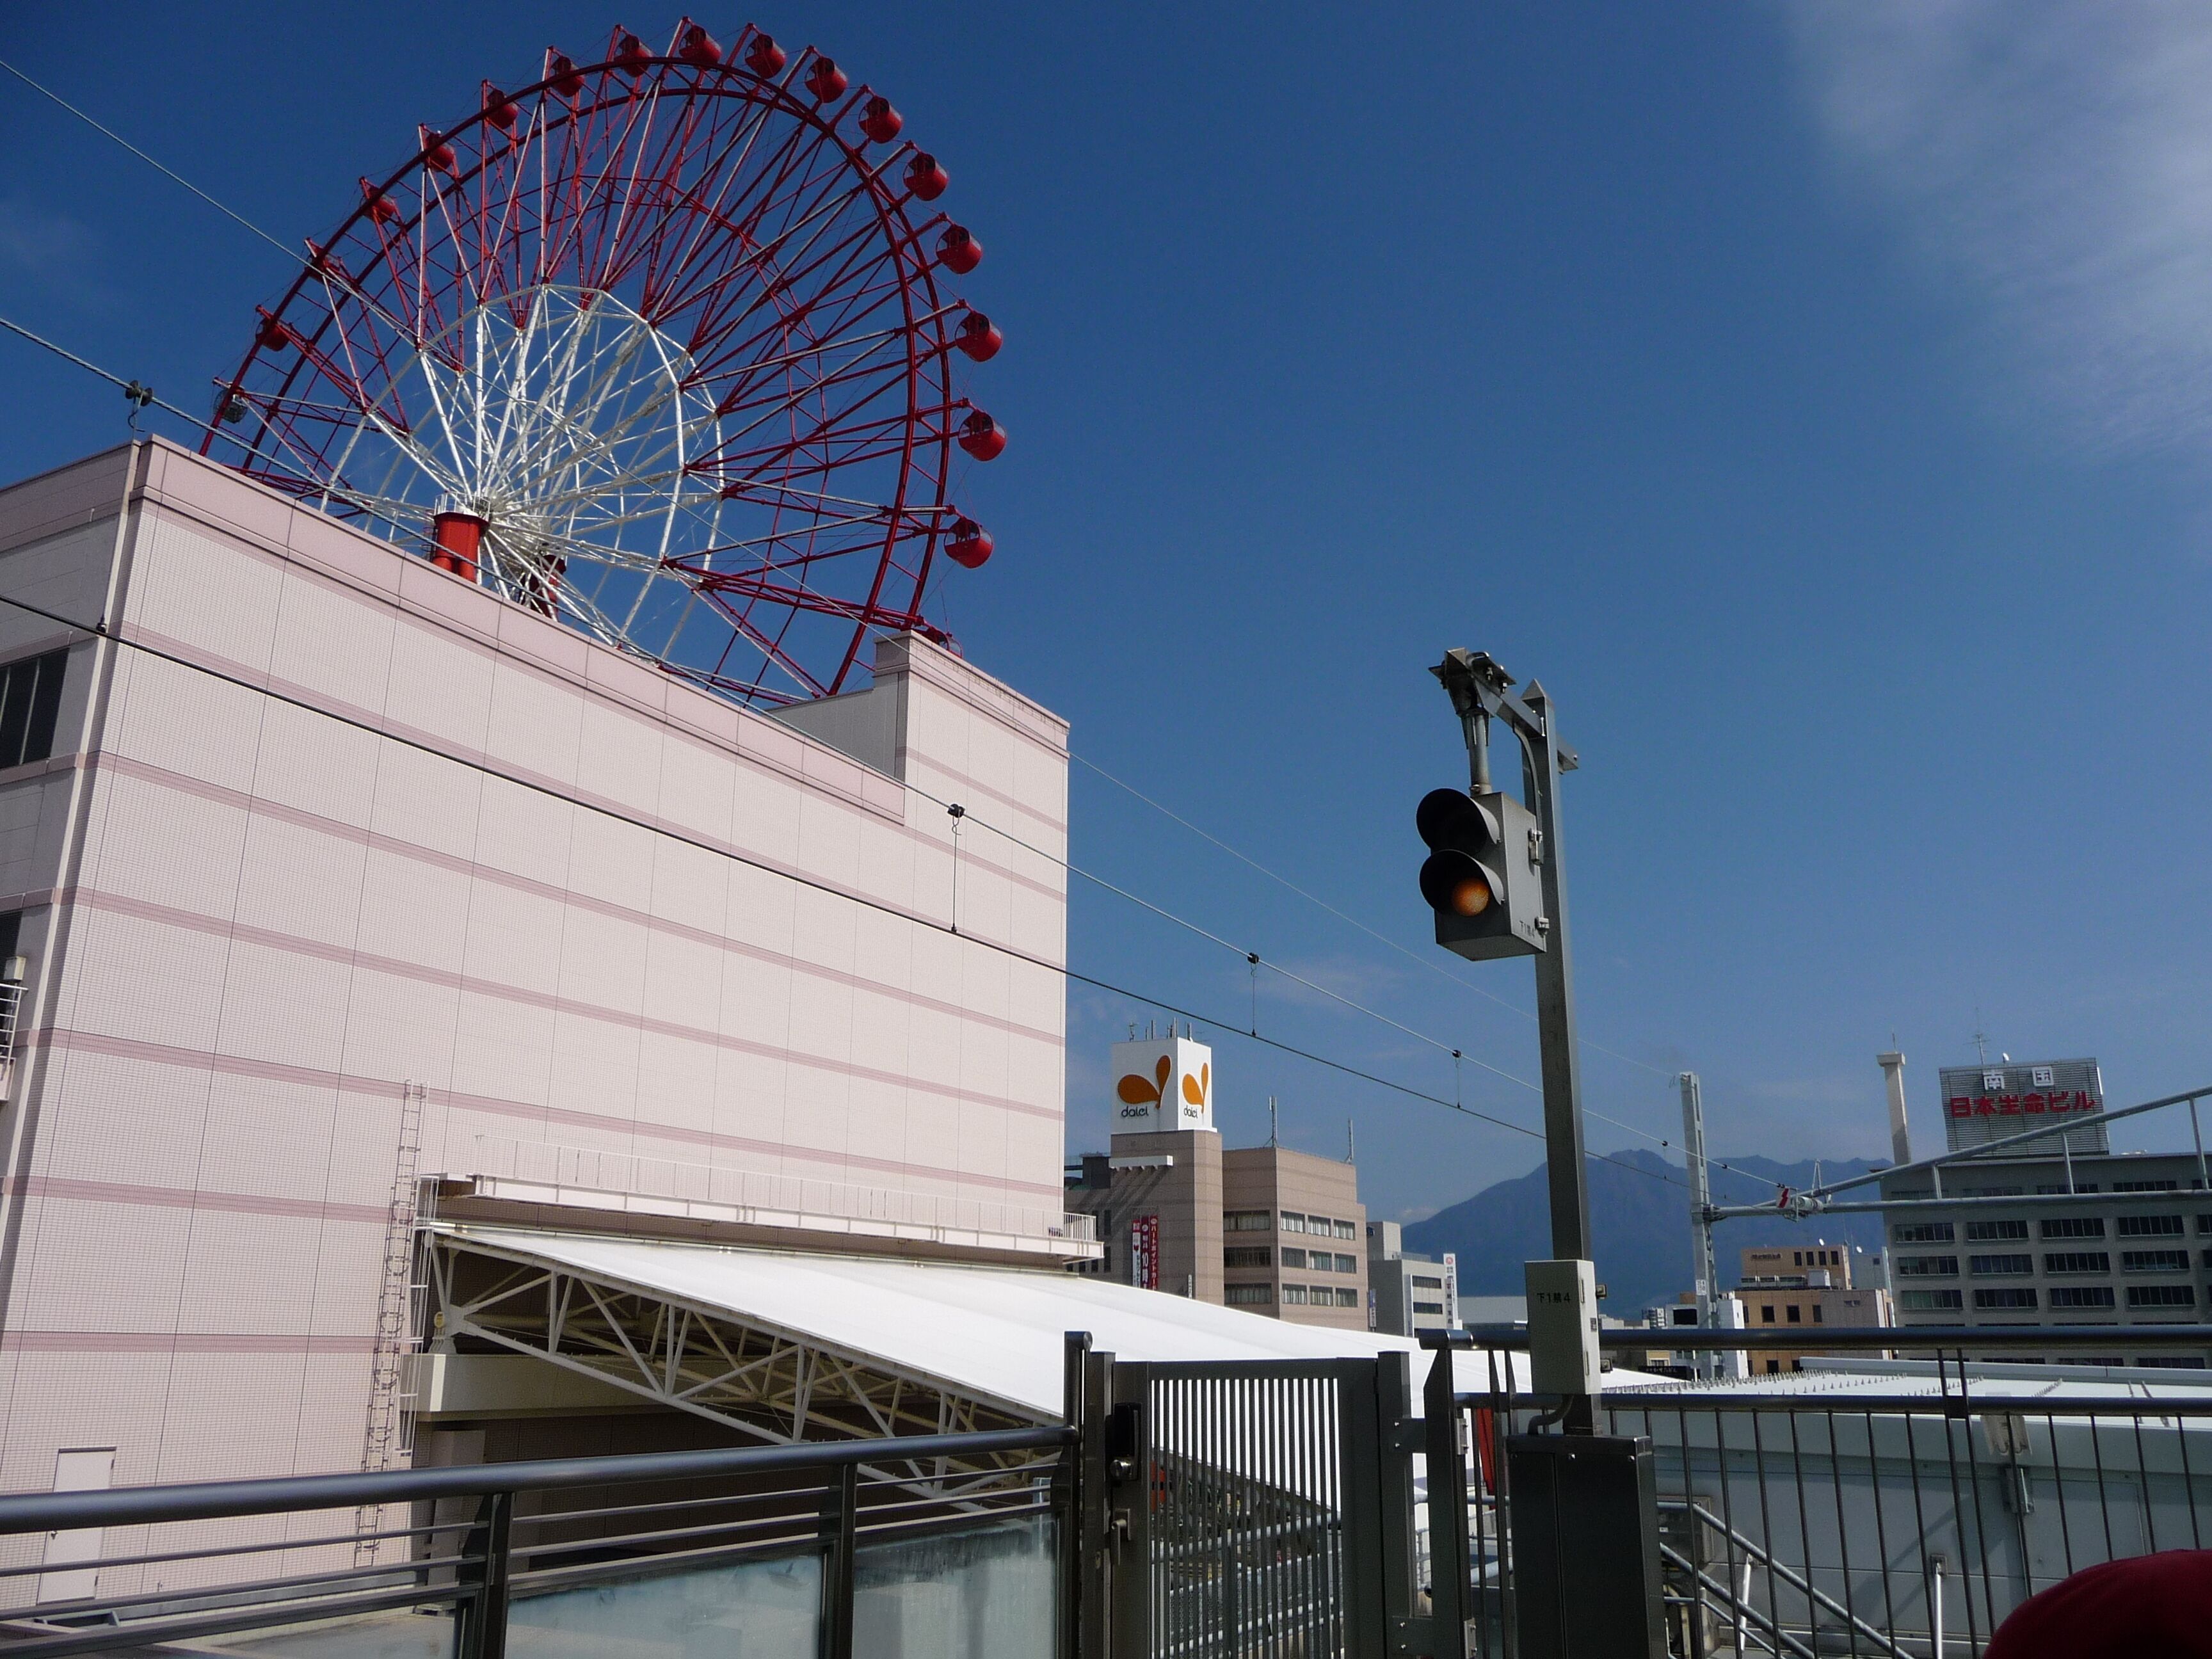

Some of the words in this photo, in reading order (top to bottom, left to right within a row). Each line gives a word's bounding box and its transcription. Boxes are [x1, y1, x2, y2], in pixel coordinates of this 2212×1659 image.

[1983, 1066, 2055, 1091] 南国
[1950, 1090, 2096, 1117] 日本生命ビル
